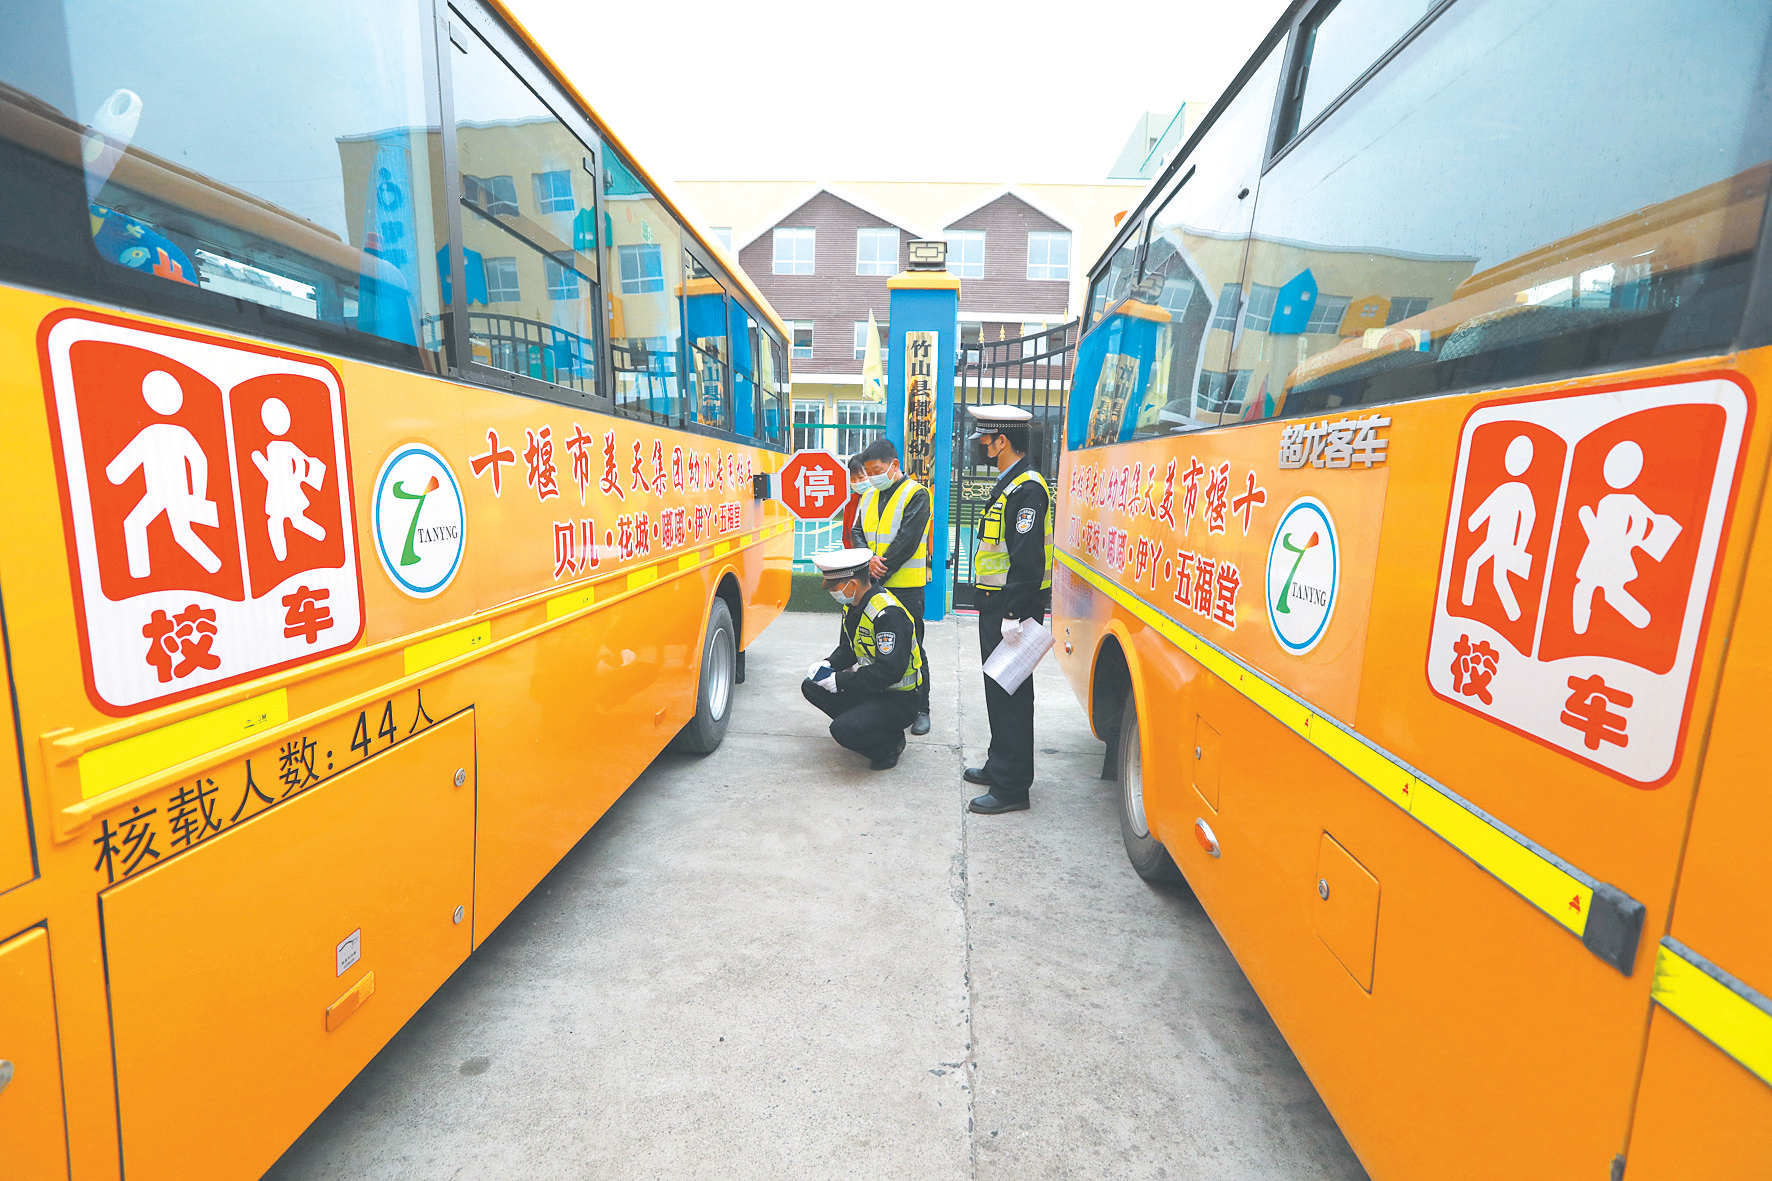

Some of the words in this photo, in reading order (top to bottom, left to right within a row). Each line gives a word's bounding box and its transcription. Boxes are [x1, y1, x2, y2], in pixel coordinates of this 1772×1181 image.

[1278, 414, 1392, 469] 超龙客车
[794, 464, 835, 508] 停
[417, 525, 458, 544] TANYNG
[980, 558, 1010, 571] POLIC
[1291, 581, 1327, 607] TANYNG
